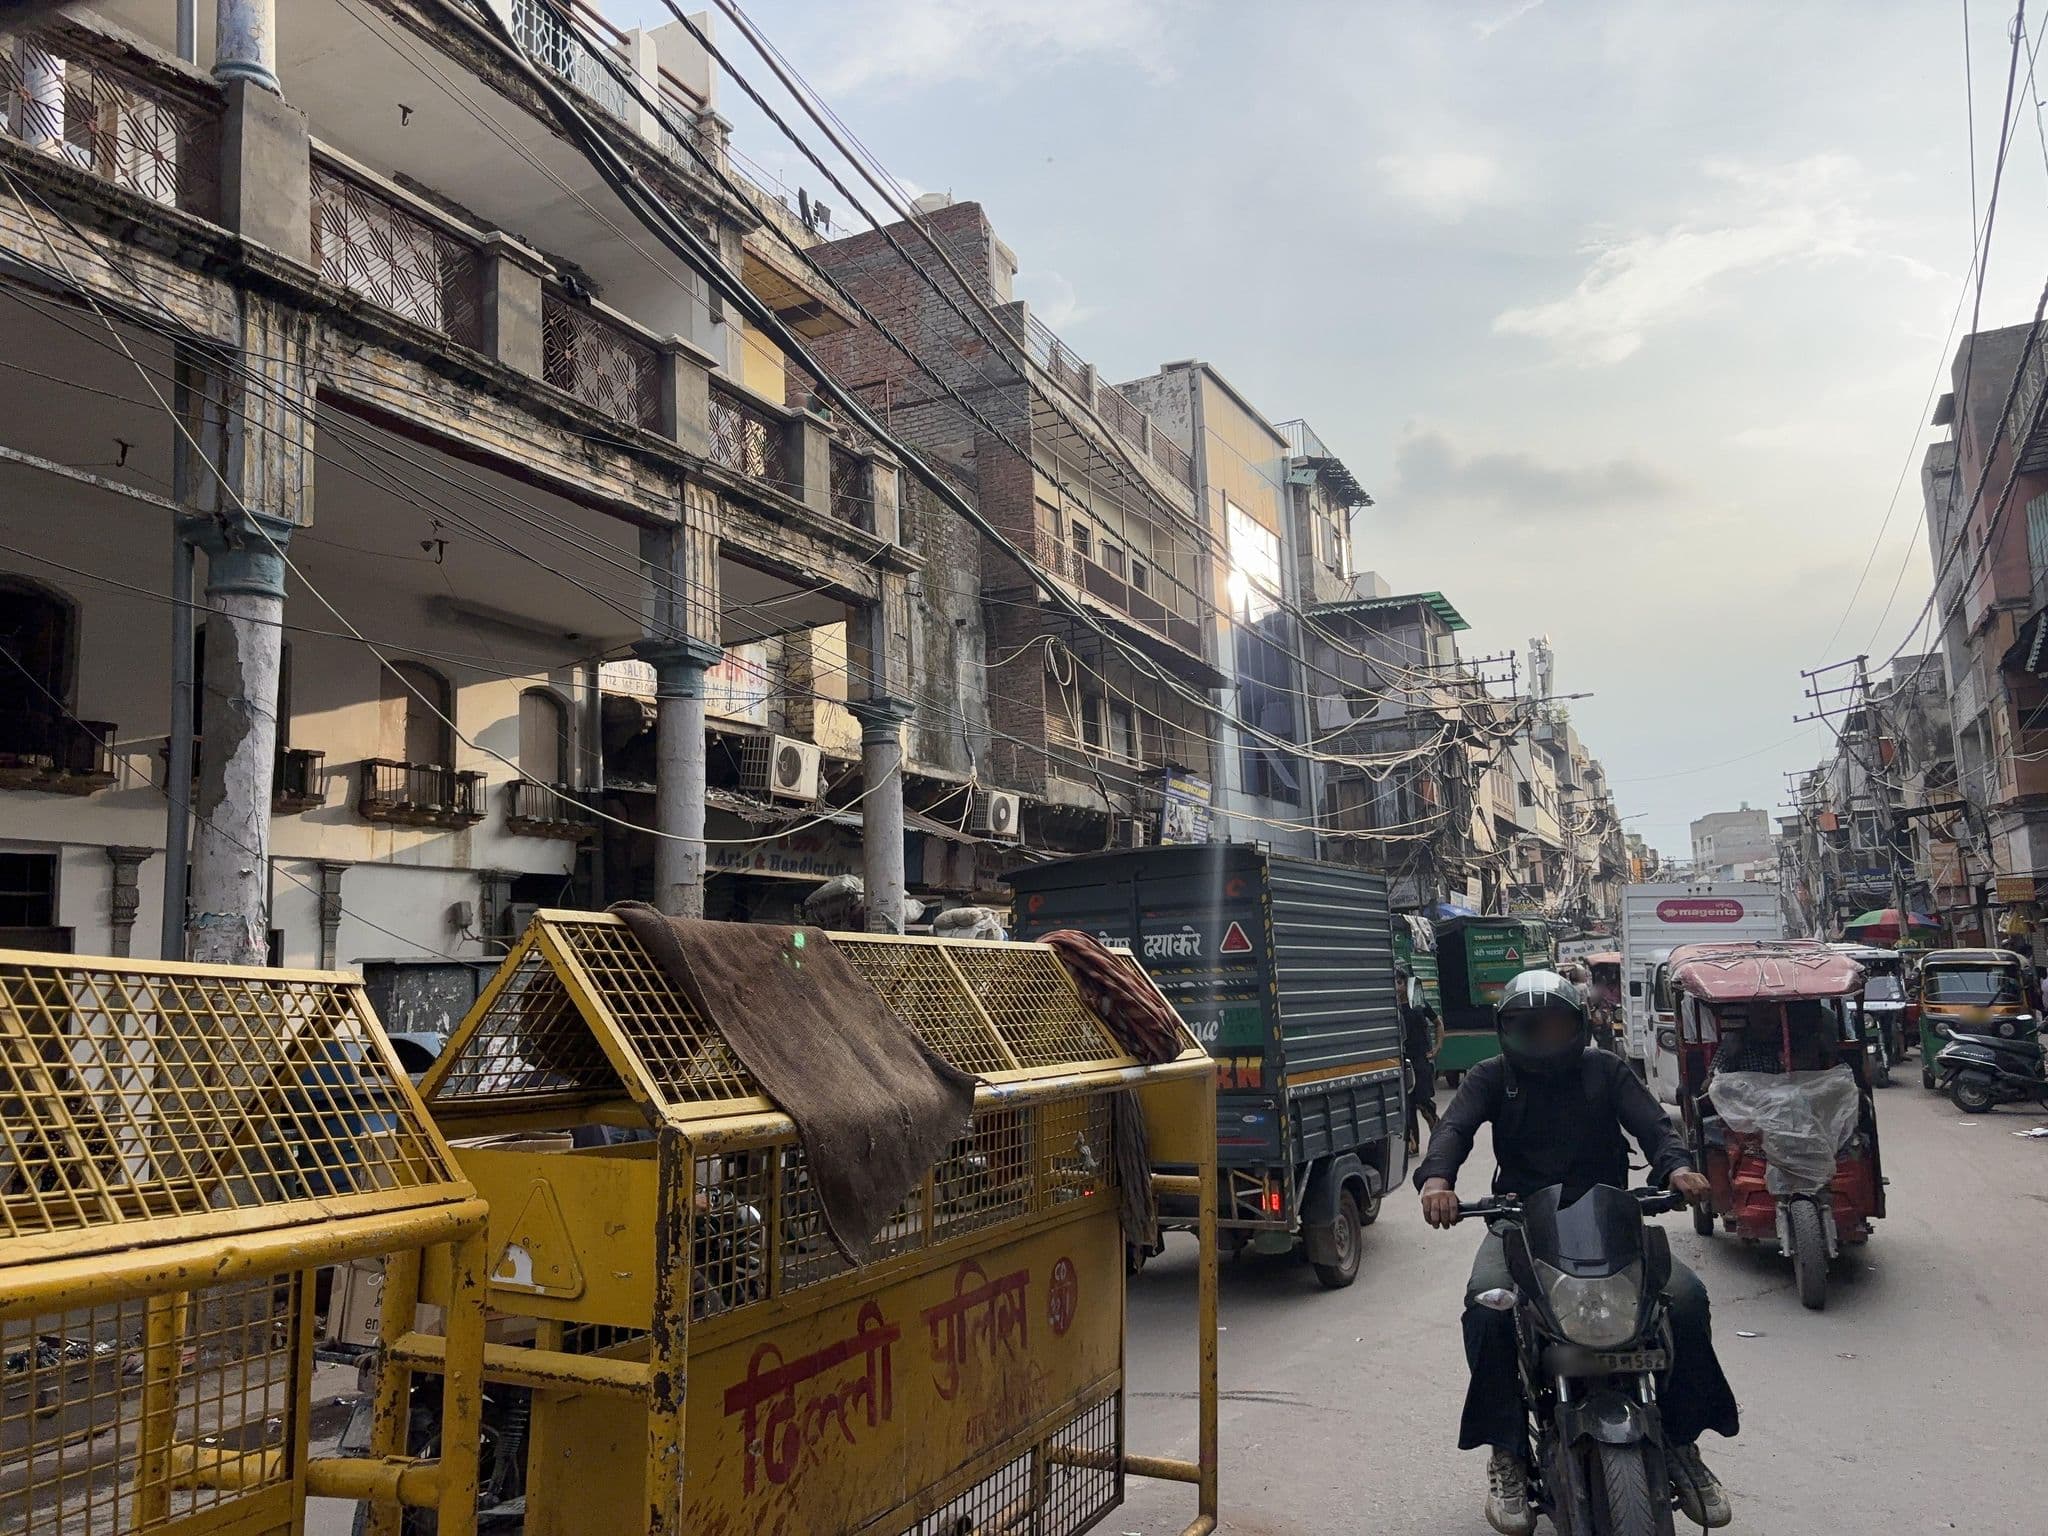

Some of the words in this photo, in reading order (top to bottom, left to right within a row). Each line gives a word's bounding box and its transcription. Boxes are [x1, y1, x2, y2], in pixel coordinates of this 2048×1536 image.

[1679, 907, 1737, 917] magenta
[723, 1301, 901, 1498] दिल्ली
[920, 1260, 1030, 1399] पुलिस
